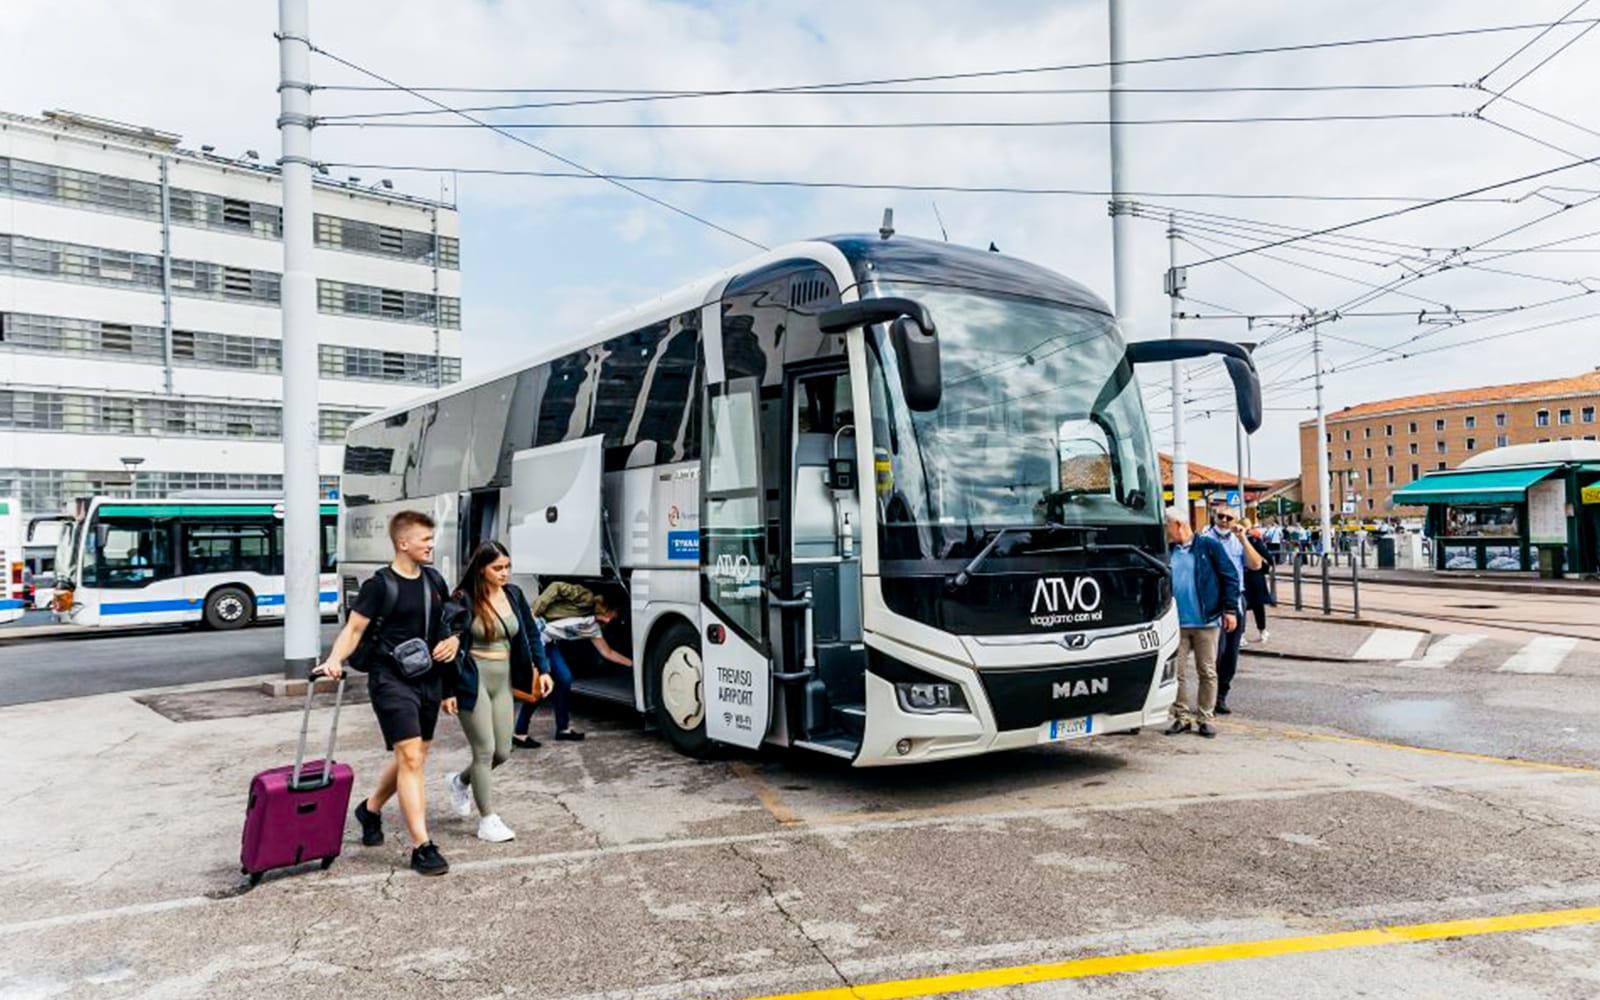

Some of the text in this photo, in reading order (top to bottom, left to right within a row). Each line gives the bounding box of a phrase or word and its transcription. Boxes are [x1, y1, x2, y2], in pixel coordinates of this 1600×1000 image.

[715, 553, 750, 579] ATVO
[1030, 576, 1101, 613] ATVO
[1030, 609, 1103, 627] viaggiamo con voi
[1138, 630, 1161, 650] 810
[716, 666, 752, 687] TREVISO
[718, 686, 753, 706] AIRPORT
[1052, 677, 1109, 699] MAN
